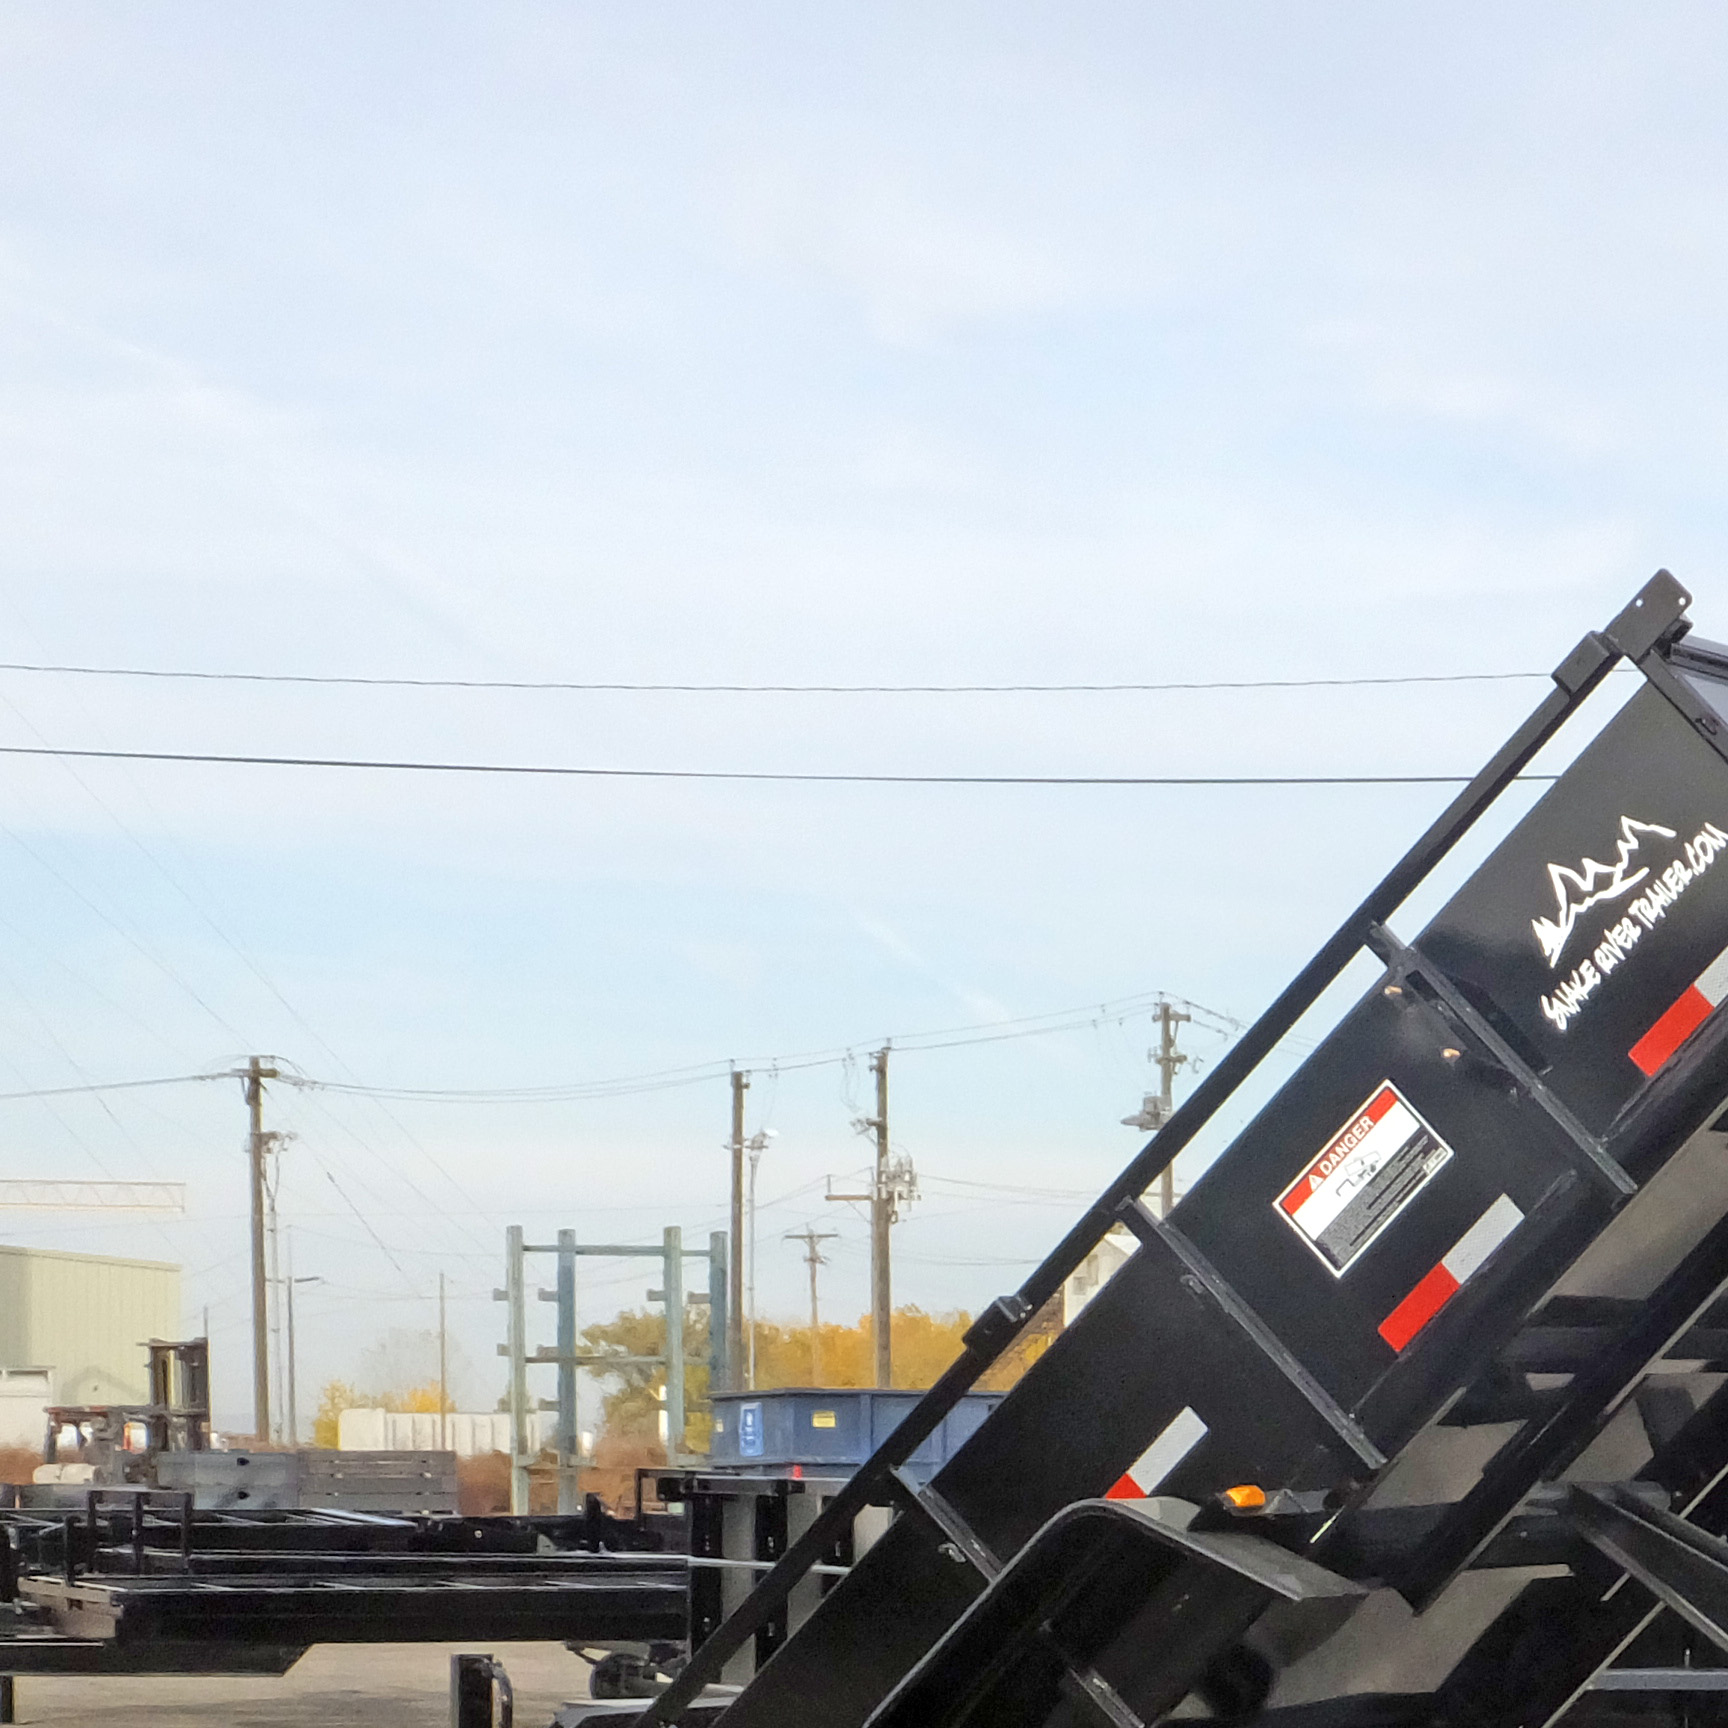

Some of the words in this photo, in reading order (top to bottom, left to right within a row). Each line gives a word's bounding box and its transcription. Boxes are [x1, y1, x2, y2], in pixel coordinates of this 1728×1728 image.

[1540, 958, 1601, 1032] SNAKE
[1594, 916, 1642, 974] RIVER
[1319, 1114, 1375, 1176] DANGER
